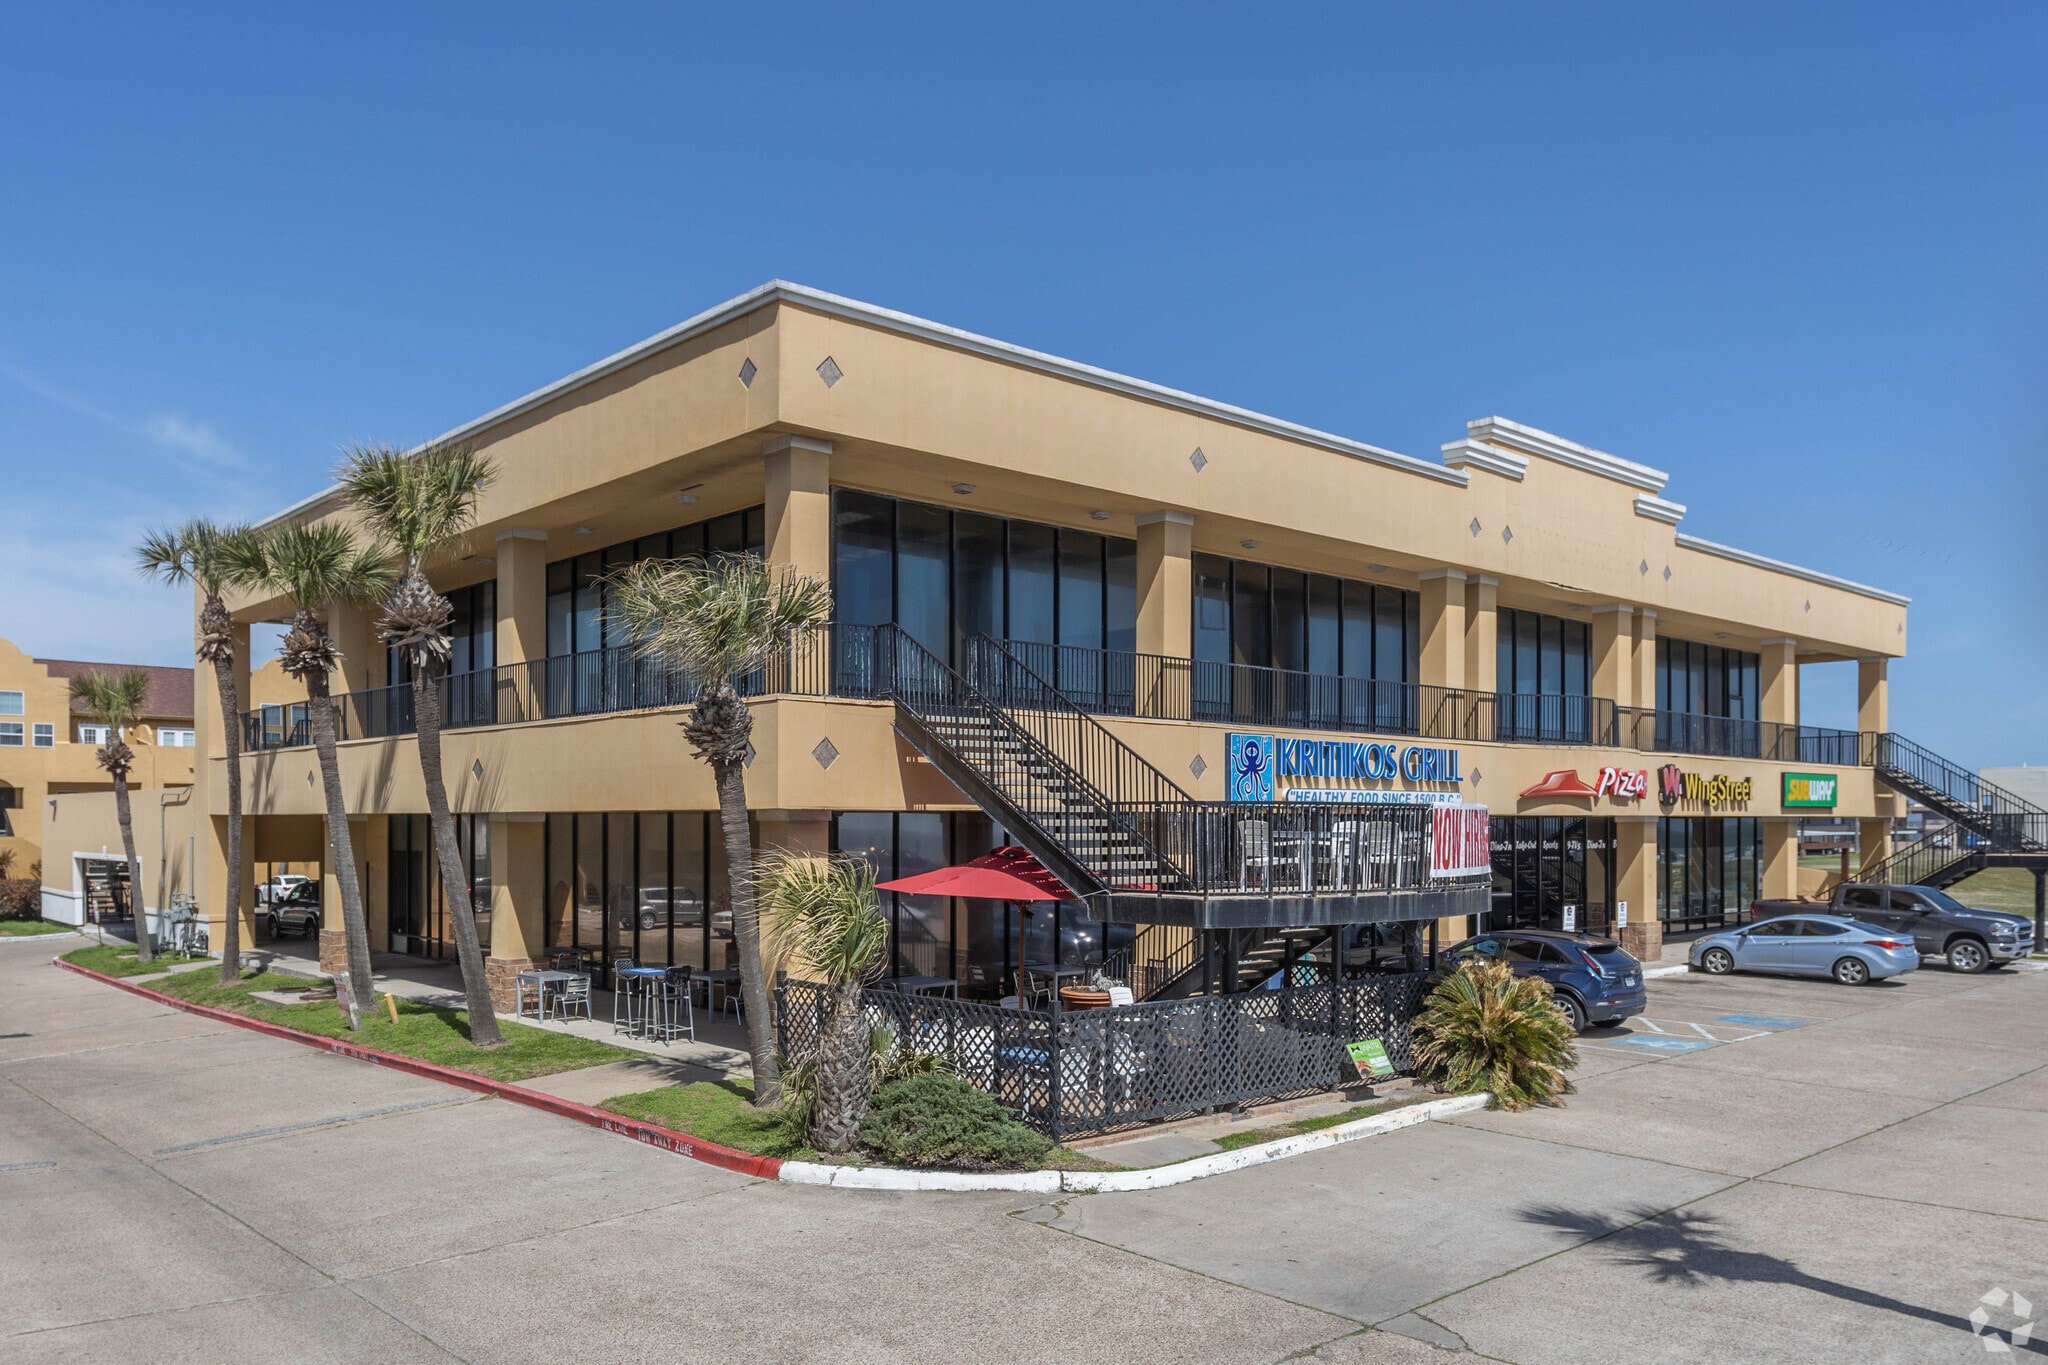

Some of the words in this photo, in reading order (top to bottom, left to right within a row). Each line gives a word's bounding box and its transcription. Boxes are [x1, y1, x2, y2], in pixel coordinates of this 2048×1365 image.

[1277, 738, 1398, 780] KRITIKOS
[1401, 746, 1464, 782] GRILL
[1598, 767, 1646, 797] Pizza
[1684, 773, 1754, 807] WingStreet
[1787, 778, 1836, 802] SUBWAY
[1350, 792, 1380, 804] FOOD
[1382, 793, 1412, 804] SINCE
[1414, 793, 1437, 805] 1500
[1433, 808, 1463, 870] NOW
[675, 1140, 693, 1157] ZONE
